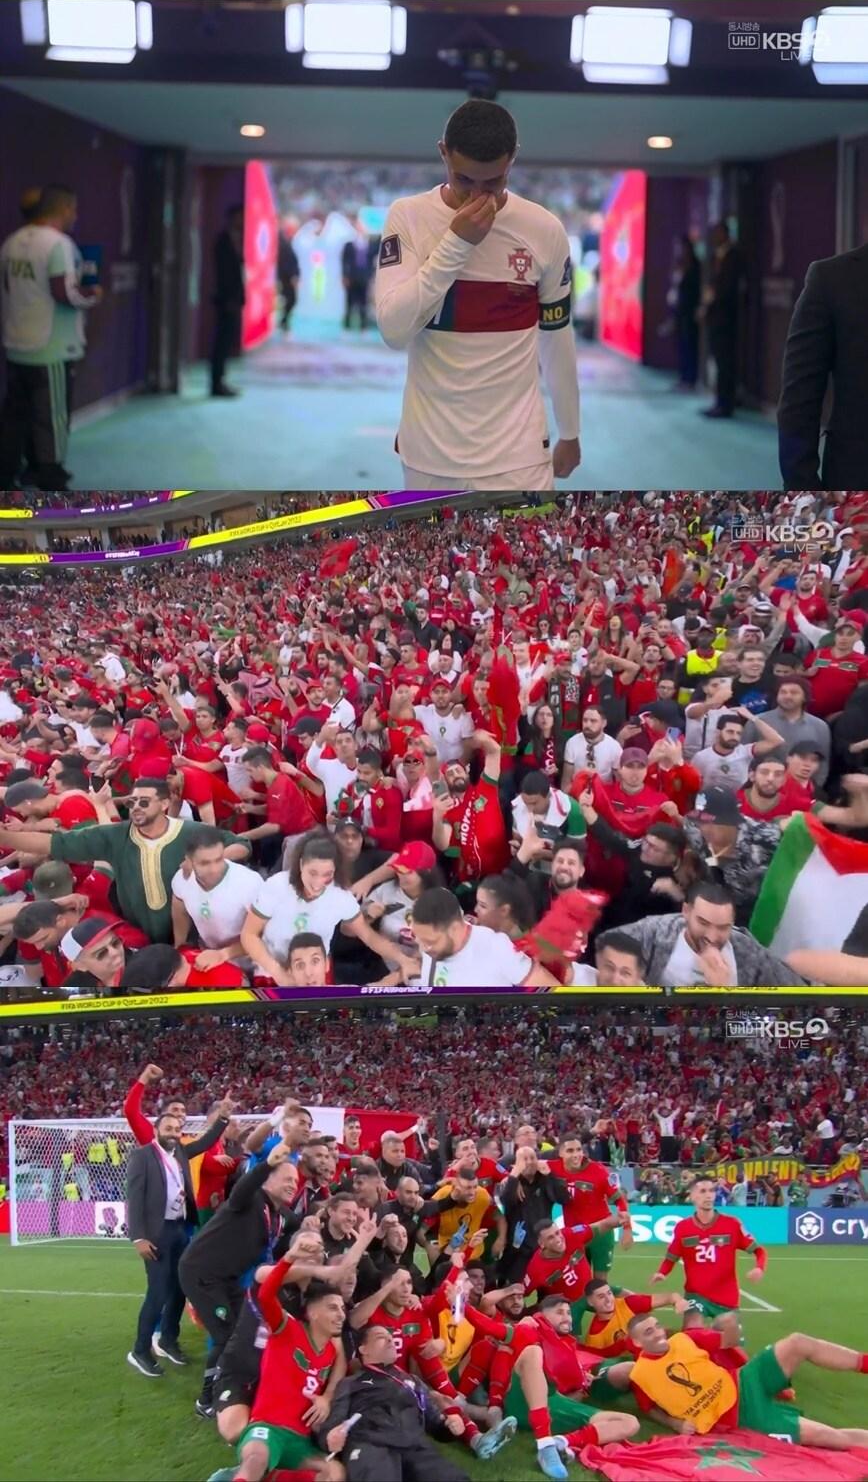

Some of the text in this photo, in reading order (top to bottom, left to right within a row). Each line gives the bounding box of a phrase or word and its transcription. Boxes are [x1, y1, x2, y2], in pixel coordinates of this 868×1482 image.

[543, 306, 563, 320] NO
[149, 996, 169, 1004] 2022
[695, 1245, 716, 1263] 24
